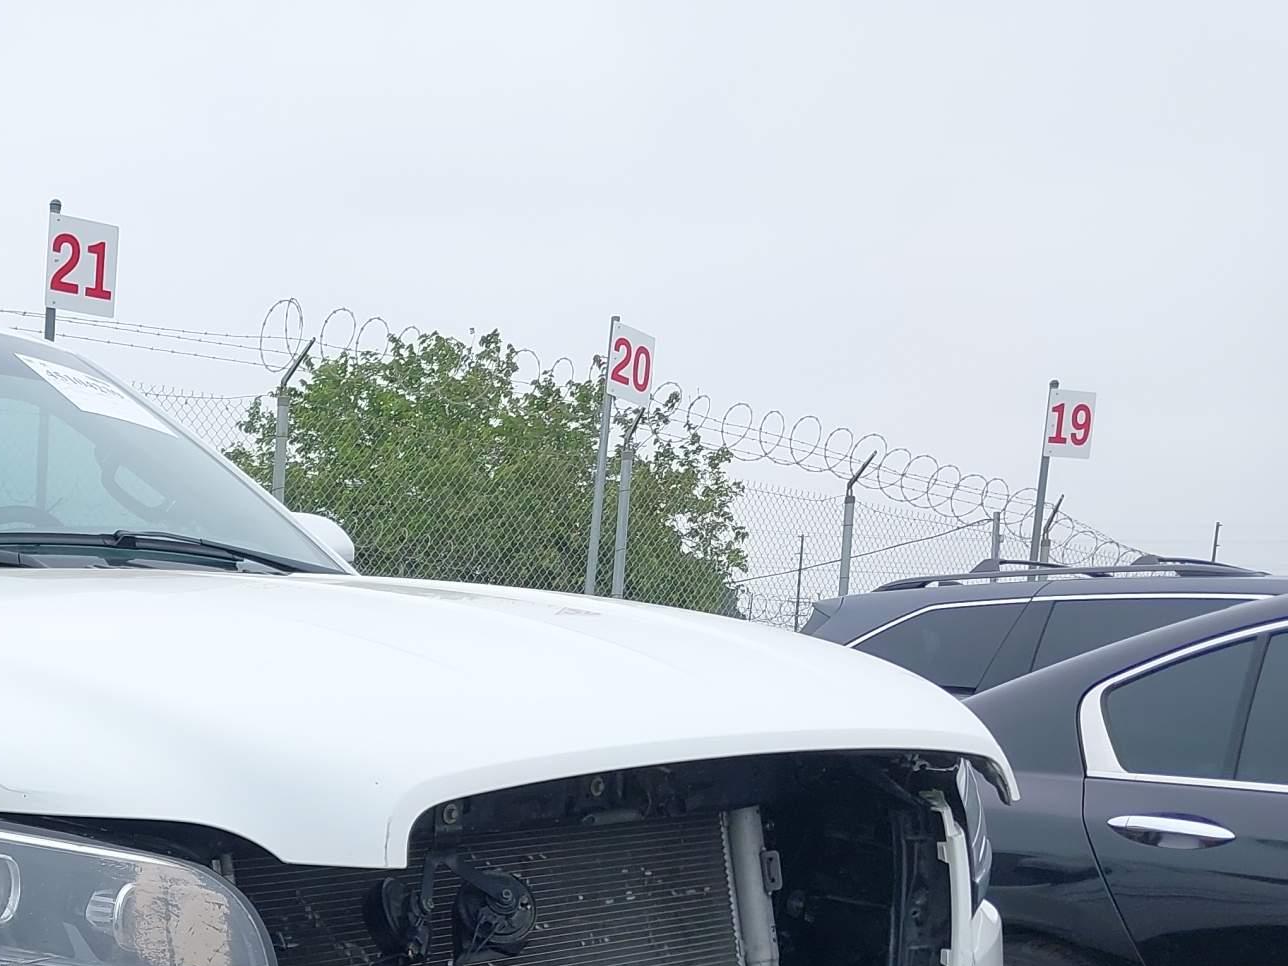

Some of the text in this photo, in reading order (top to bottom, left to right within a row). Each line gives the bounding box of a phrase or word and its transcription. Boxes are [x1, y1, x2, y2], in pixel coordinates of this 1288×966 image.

[50, 233, 112, 301] 21
[610, 337, 651, 393] 20
[1047, 402, 1092, 446] 19
